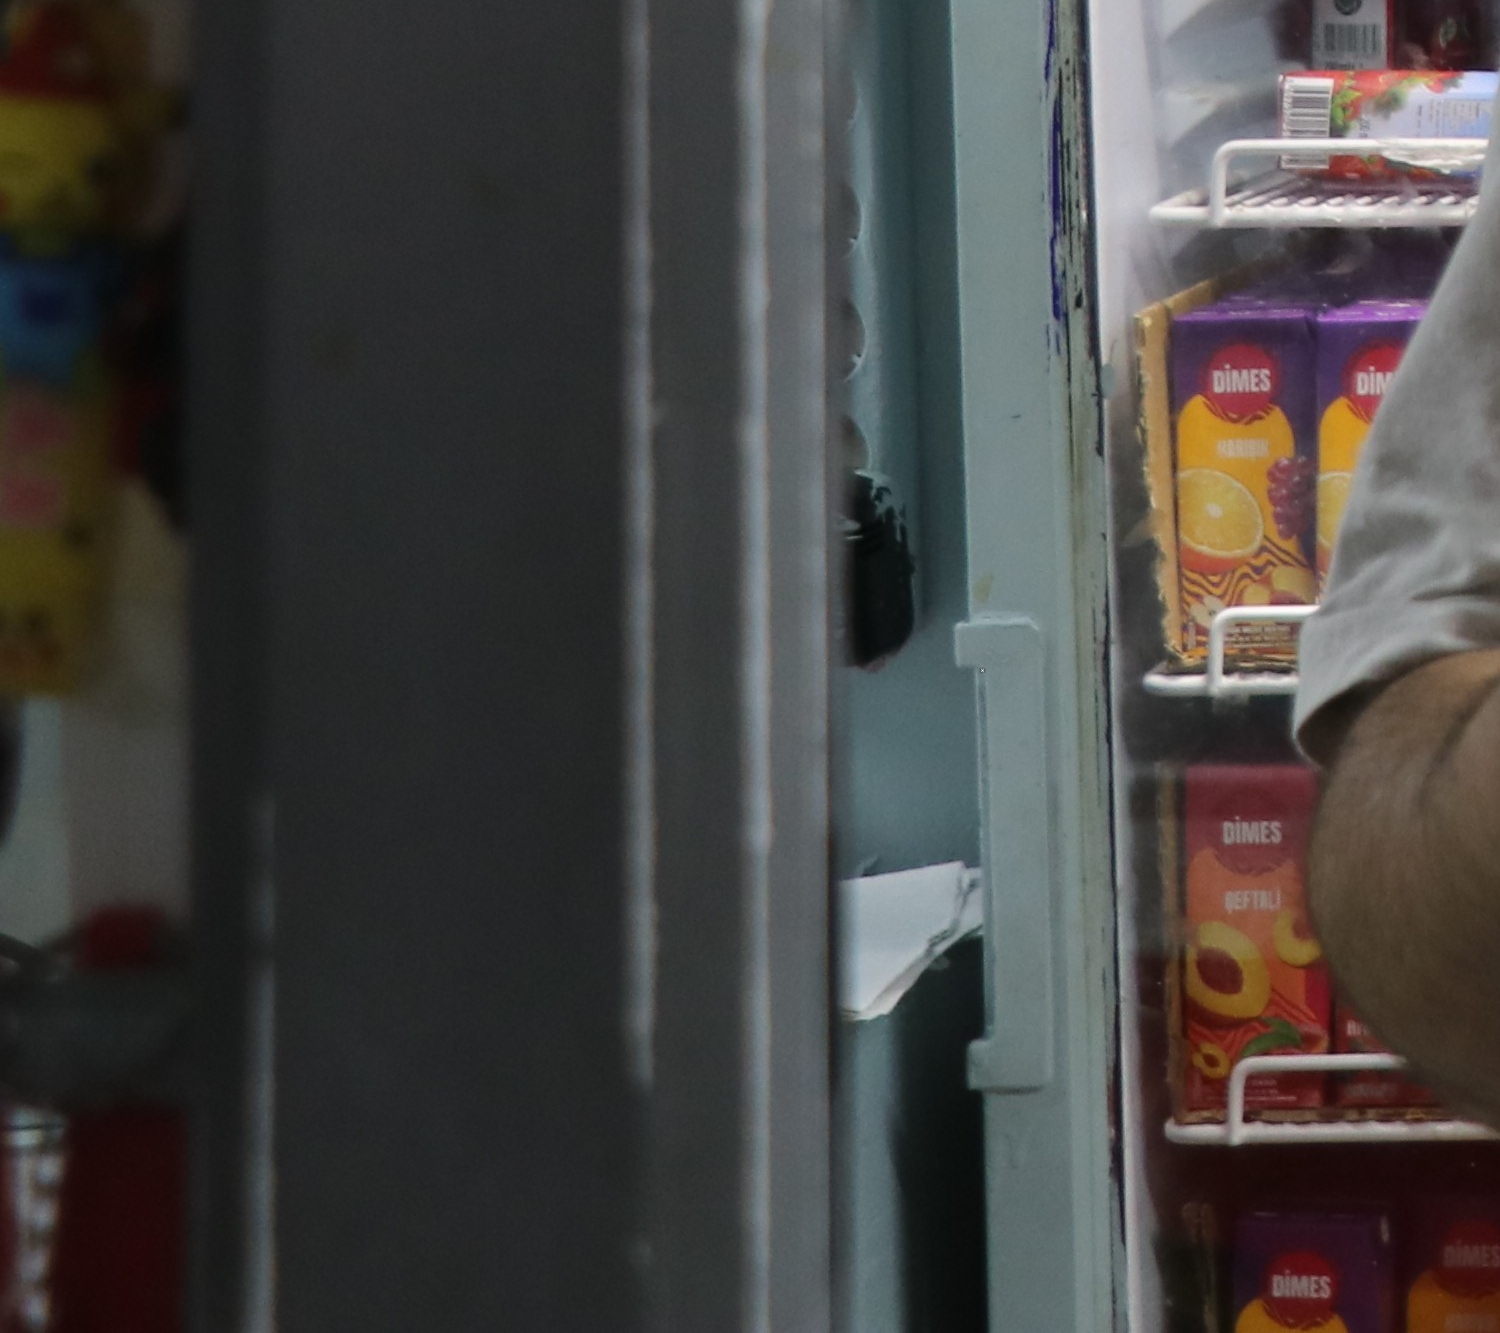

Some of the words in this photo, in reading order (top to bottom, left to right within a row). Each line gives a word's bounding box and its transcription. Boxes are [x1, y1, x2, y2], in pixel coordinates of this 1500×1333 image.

[1213, 364, 1271, 394] DİMES
[1222, 816, 1282, 845] DİMES
[1272, 1269, 1331, 1299] DİMES
